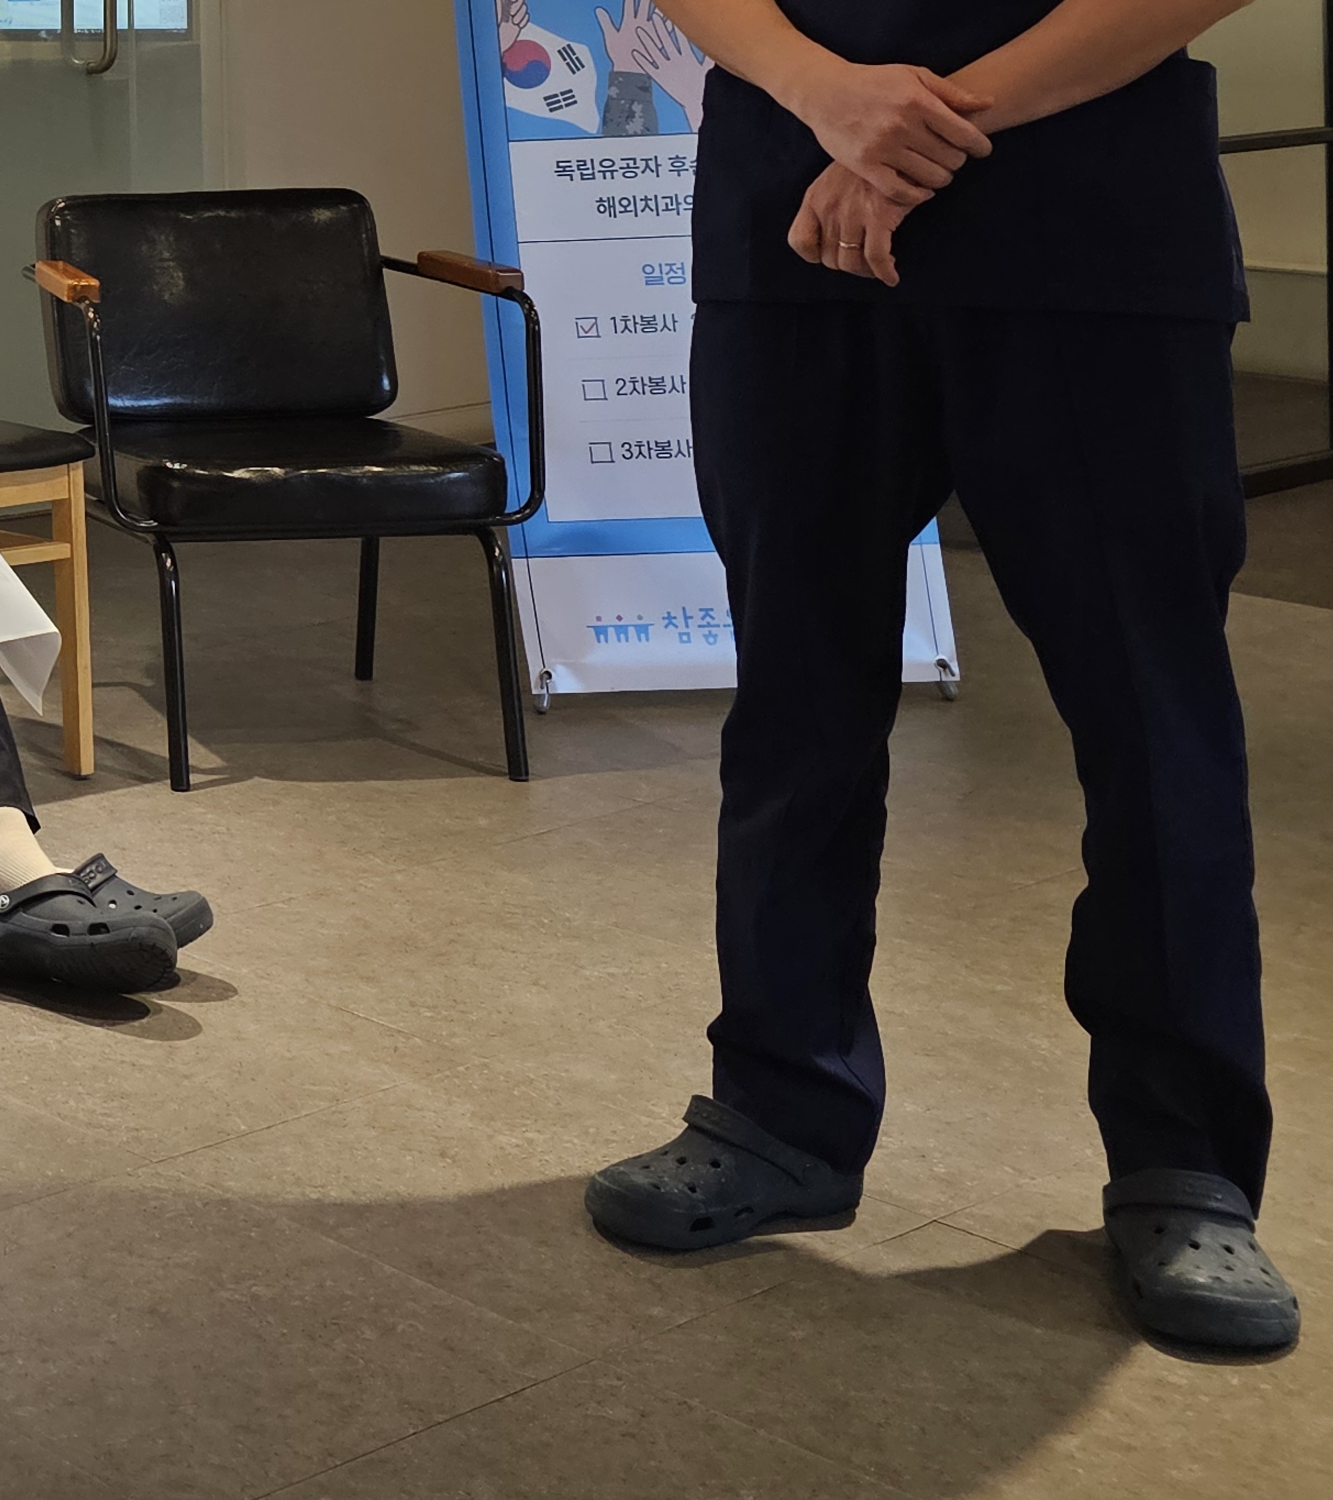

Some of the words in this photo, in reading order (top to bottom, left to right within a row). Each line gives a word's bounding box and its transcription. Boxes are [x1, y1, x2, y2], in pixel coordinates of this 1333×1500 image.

[554, 155, 663, 182] 독립유공자
[641, 262, 687, 286] 일정
[609, 313, 679, 334] 1차봉사
[615, 375, 687, 396] 2차봉사
[620, 439, 694, 461] 3차봉사
